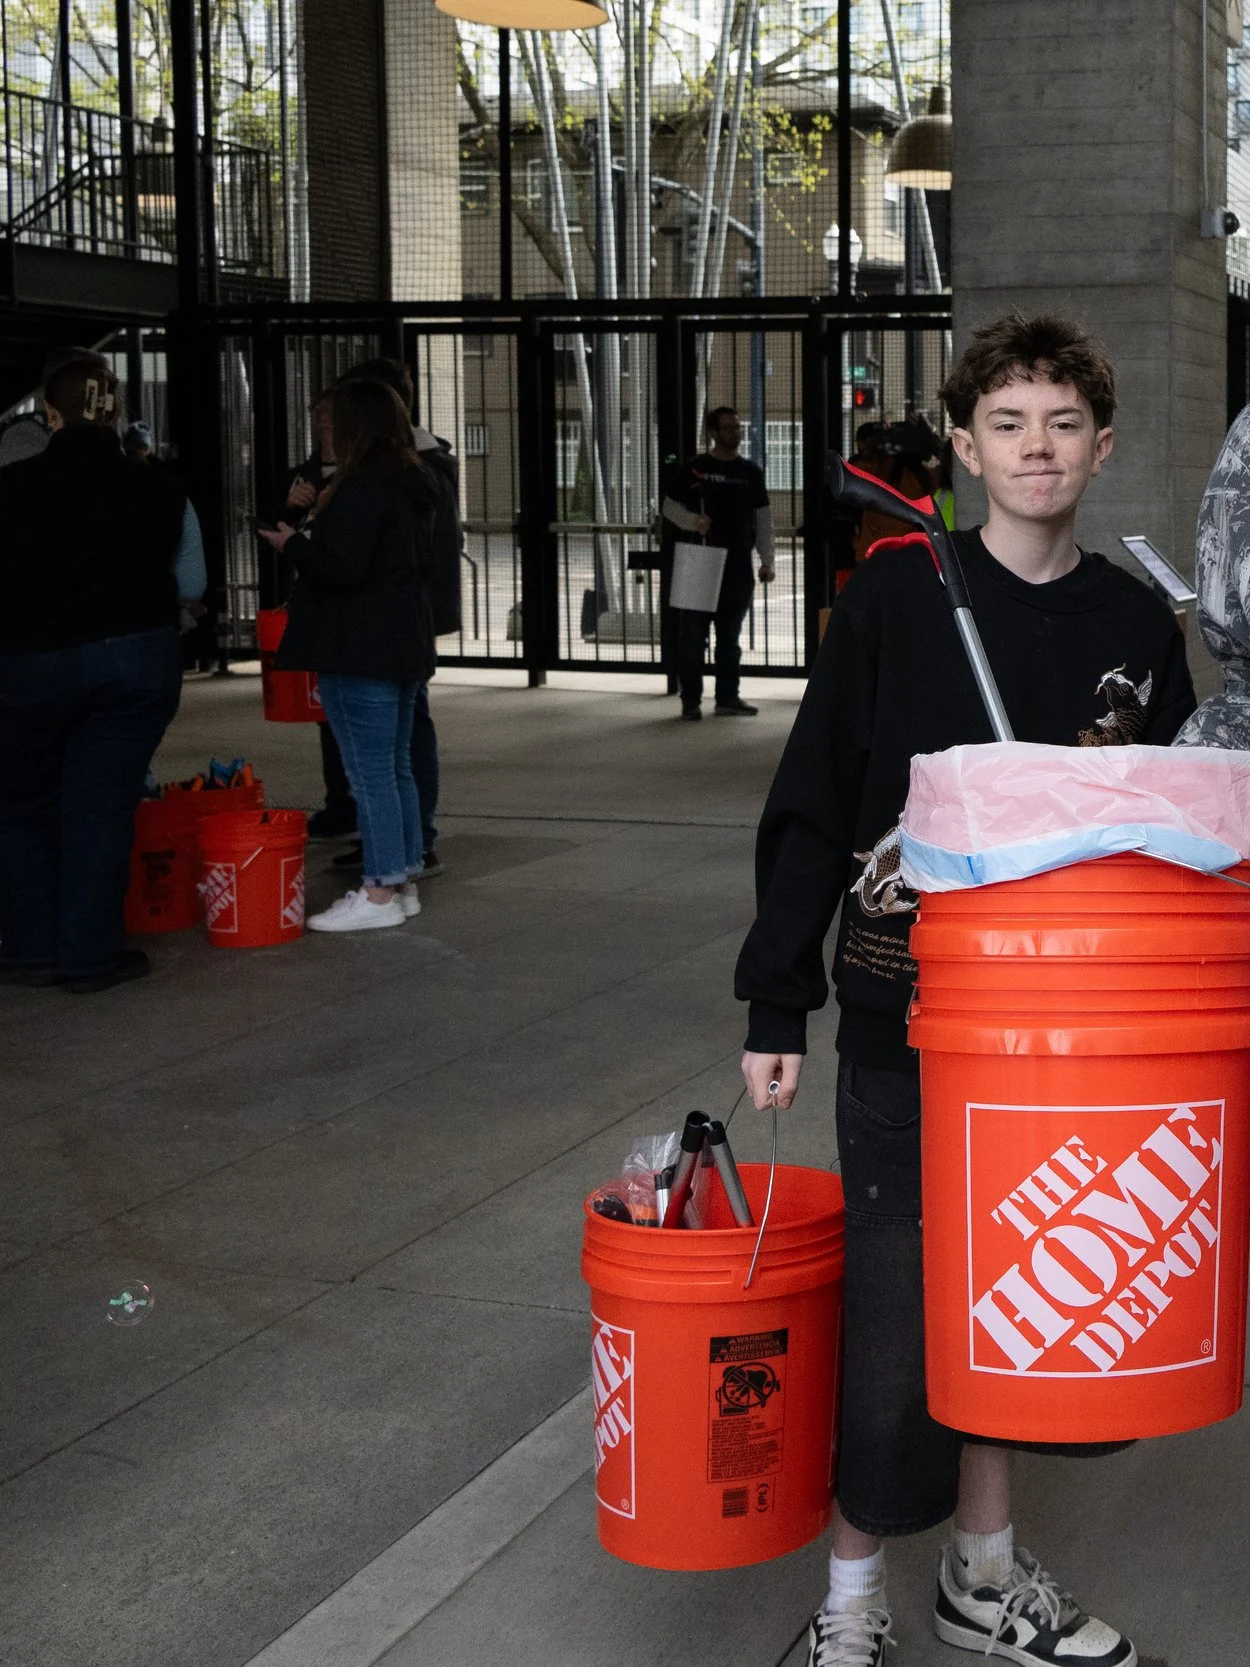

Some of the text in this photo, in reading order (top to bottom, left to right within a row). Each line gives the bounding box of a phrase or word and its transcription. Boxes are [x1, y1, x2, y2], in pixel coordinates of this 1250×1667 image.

[972, 1105, 1221, 1371] HOME
[991, 1135, 1108, 1241] THE
[1069, 1198, 1219, 1372] DEPOT
